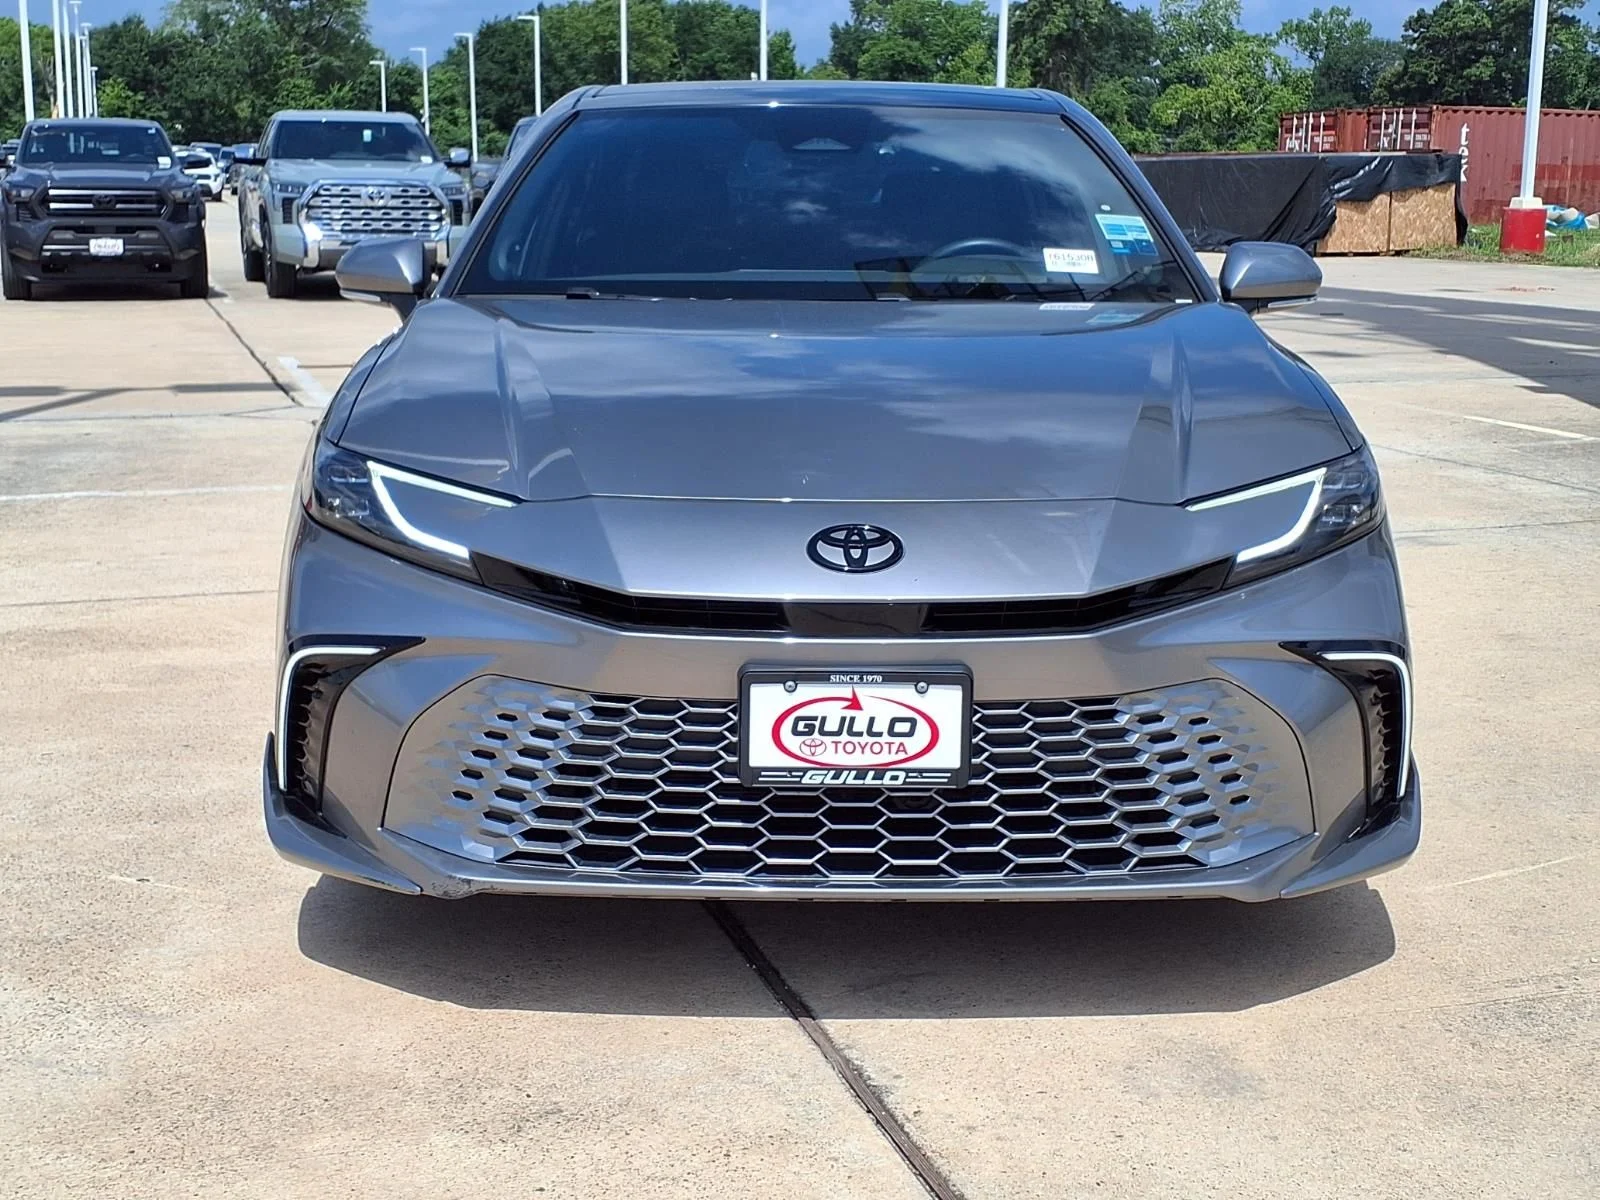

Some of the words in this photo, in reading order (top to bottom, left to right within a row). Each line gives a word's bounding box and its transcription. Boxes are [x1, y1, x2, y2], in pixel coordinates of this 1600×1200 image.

[830, 674, 860, 683] SINCE
[862, 674, 883, 683] 1970
[791, 715, 918, 737] GULLO
[832, 741, 908, 755] TOYOTA
[801, 770, 906, 785] GULLO
